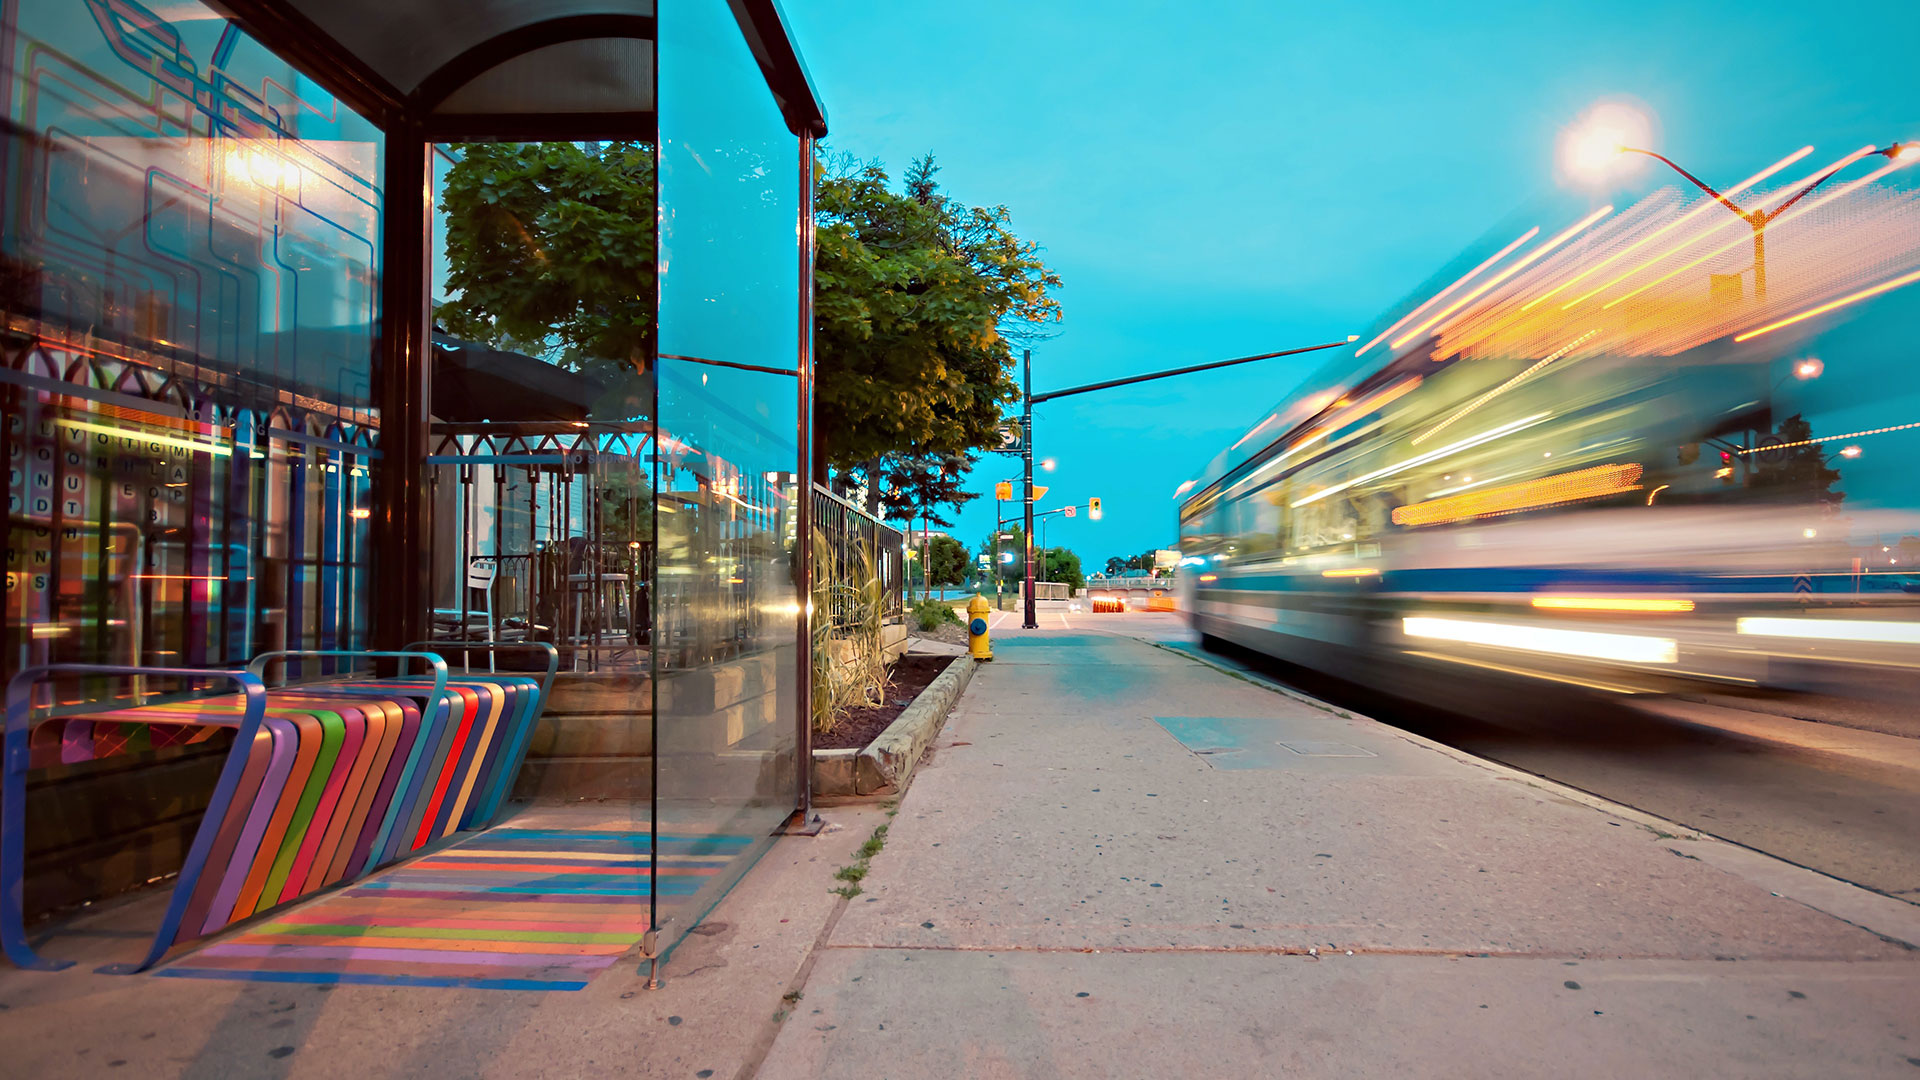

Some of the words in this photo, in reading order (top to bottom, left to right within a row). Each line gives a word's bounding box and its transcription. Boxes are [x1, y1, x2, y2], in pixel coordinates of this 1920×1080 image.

[184, 408, 201, 421] NO
[209, 414, 266, 436] SMOKNG
[97, 433, 109, 470] ON
[124, 438, 134, 496] THE
[174, 447, 184, 501] MAP
[566, 454, 583, 464] NO
[588, 454, 637, 464] SMOKIN
[66, 428, 80, 540] YOUTH
[149, 442, 160, 567] GLOBAL
